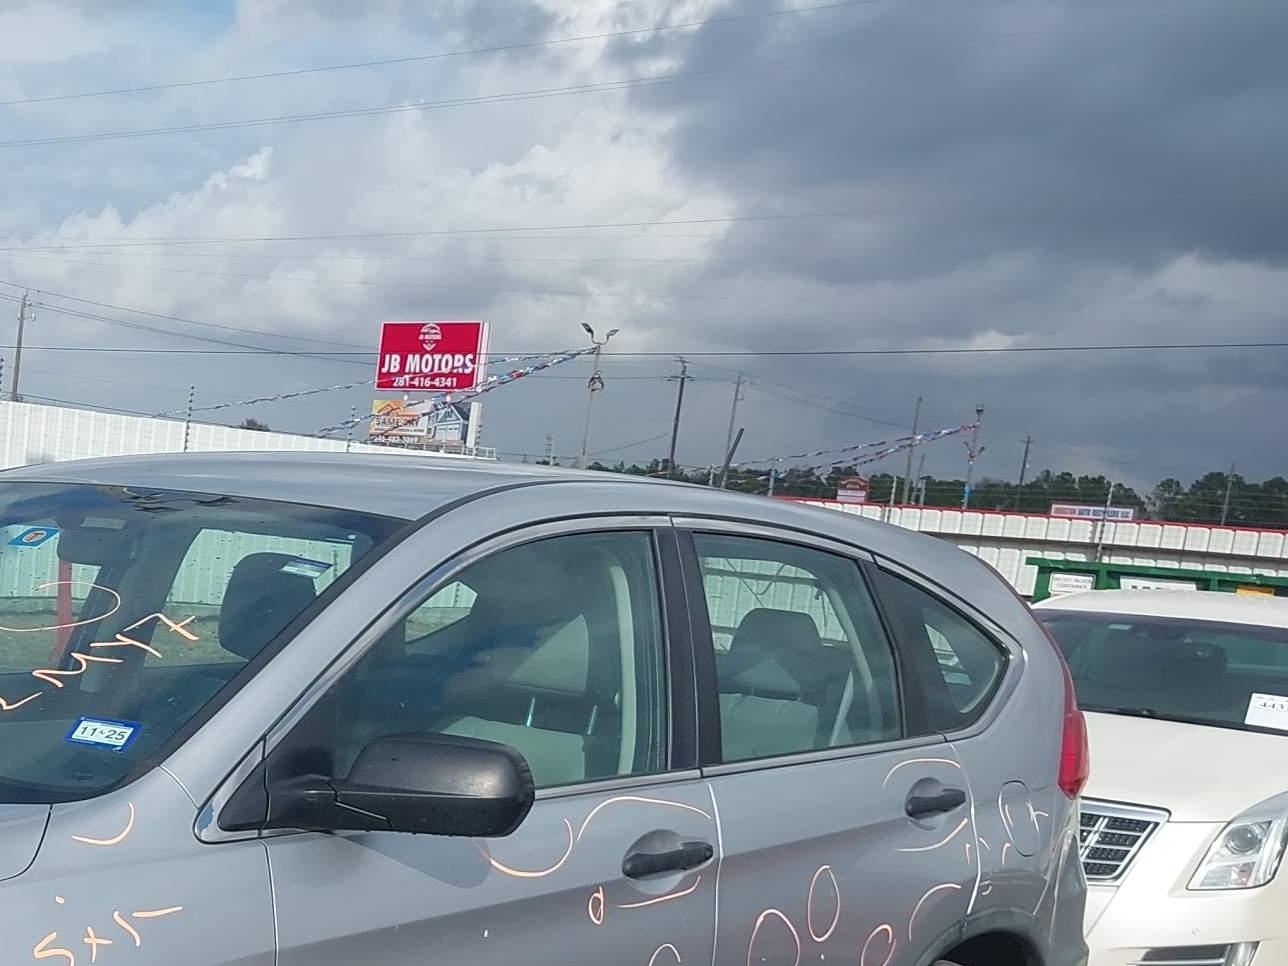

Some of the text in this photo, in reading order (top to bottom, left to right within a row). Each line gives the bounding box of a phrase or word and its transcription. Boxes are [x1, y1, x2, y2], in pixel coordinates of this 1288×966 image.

[381, 353, 474, 374] JB MOTORS
[393, 376, 457, 387] 281-416-4341
